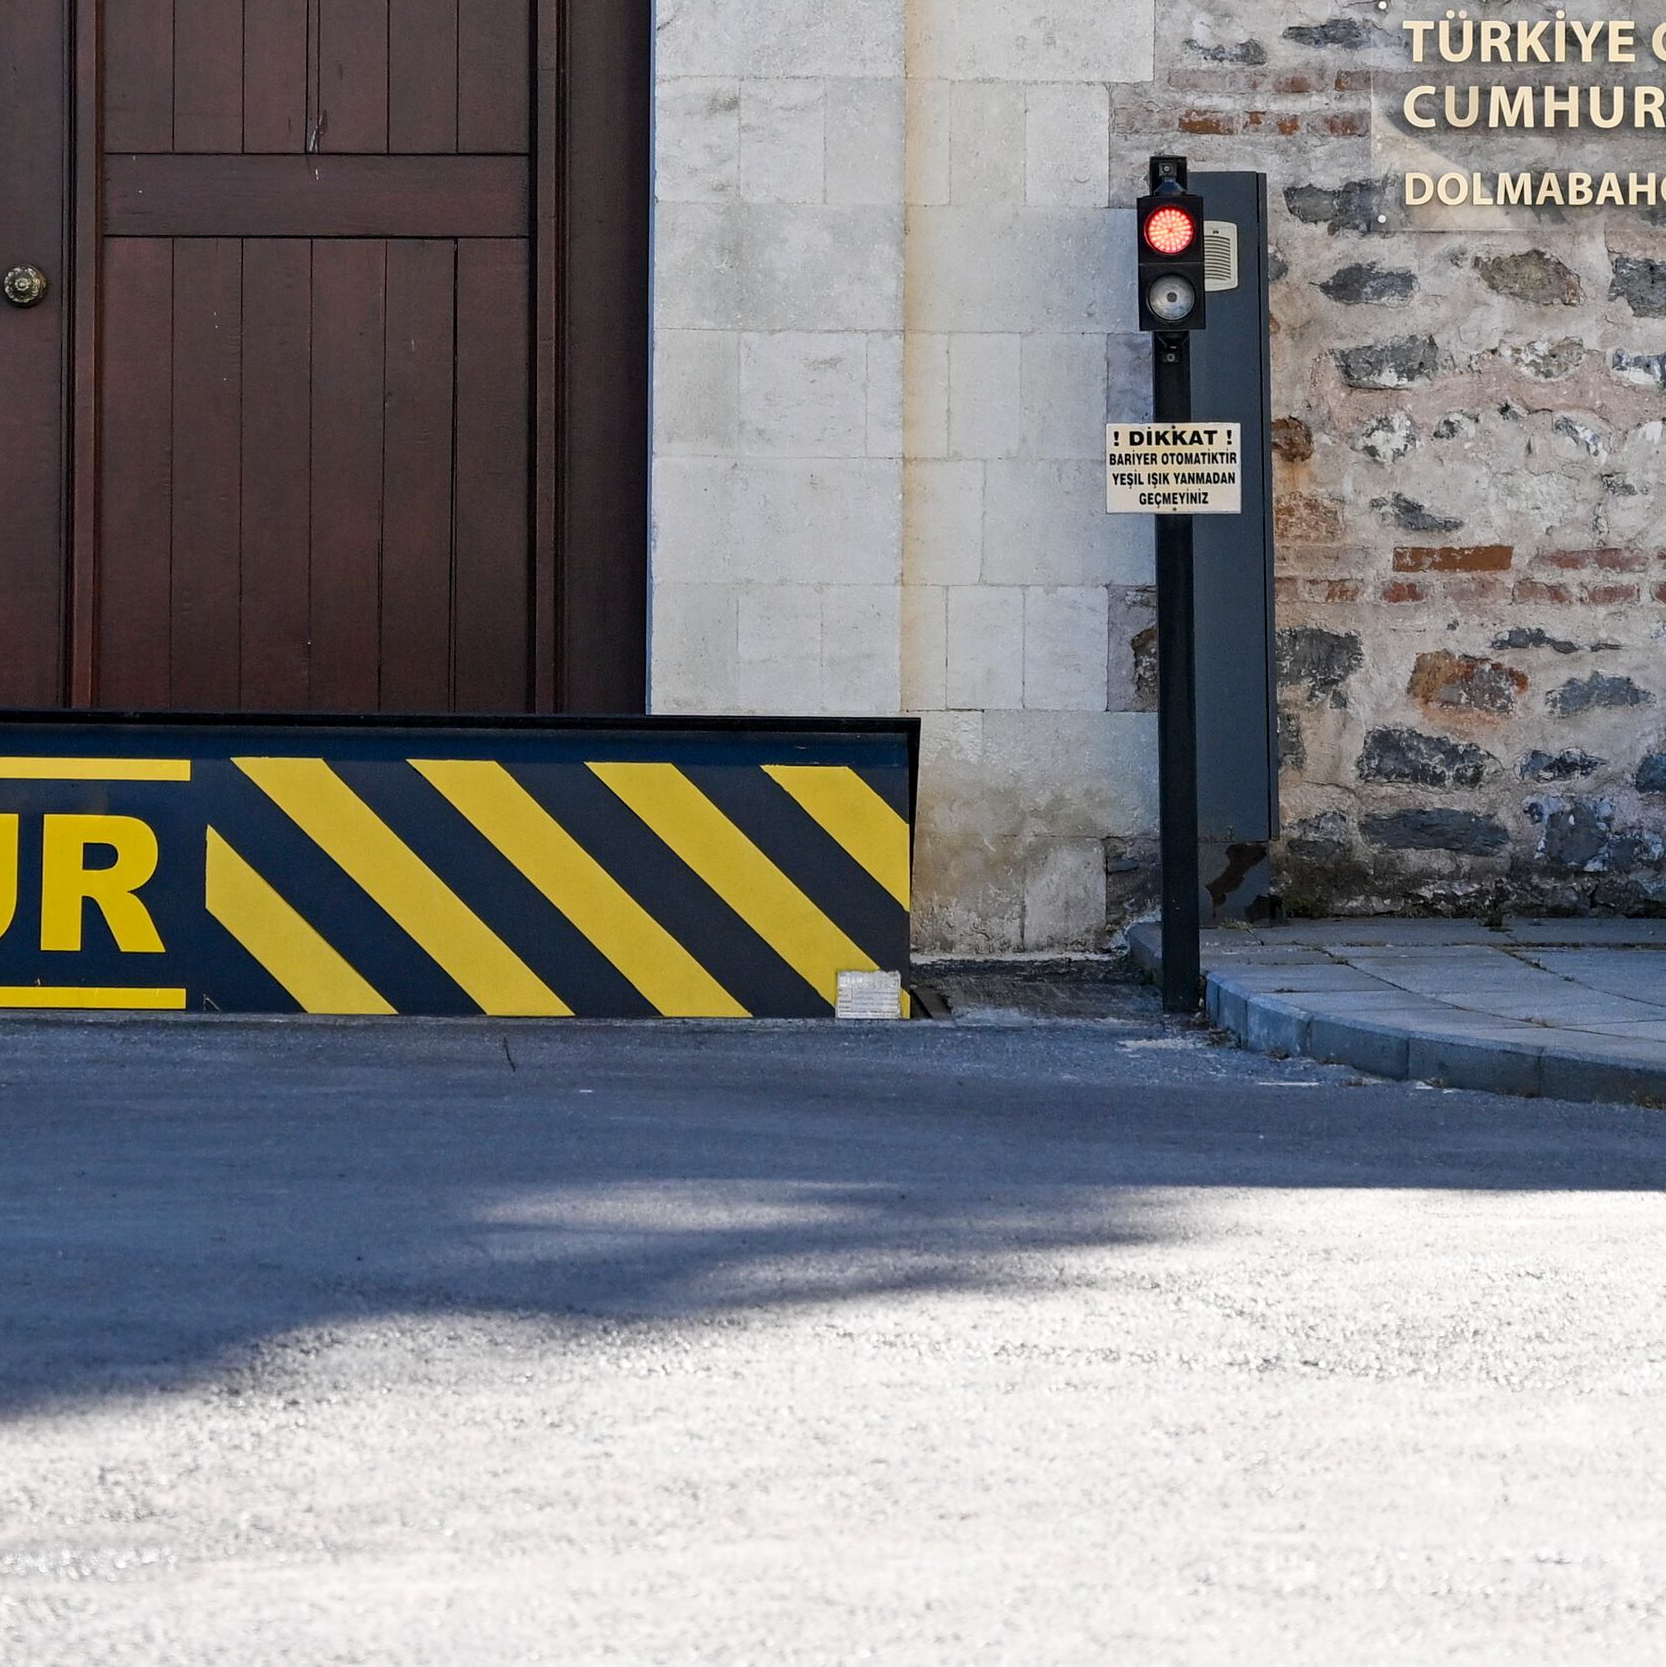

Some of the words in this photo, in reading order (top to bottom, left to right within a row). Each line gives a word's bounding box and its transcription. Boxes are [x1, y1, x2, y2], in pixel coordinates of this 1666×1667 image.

[1402, 9, 1637, 64] TÜRKİYE
[1128, 426, 1218, 447] DİKKAT
[1109, 449, 1158, 466] BARİYER
[1161, 447, 1238, 466] OTOMATİKTİR
[1112, 469, 1145, 490] YEŞİL
[1147, 472, 1170, 490] IŞIK
[1173, 471, 1236, 486] YANMADAN
[1138, 488, 1210, 509] GEÇMEYİNİZ
